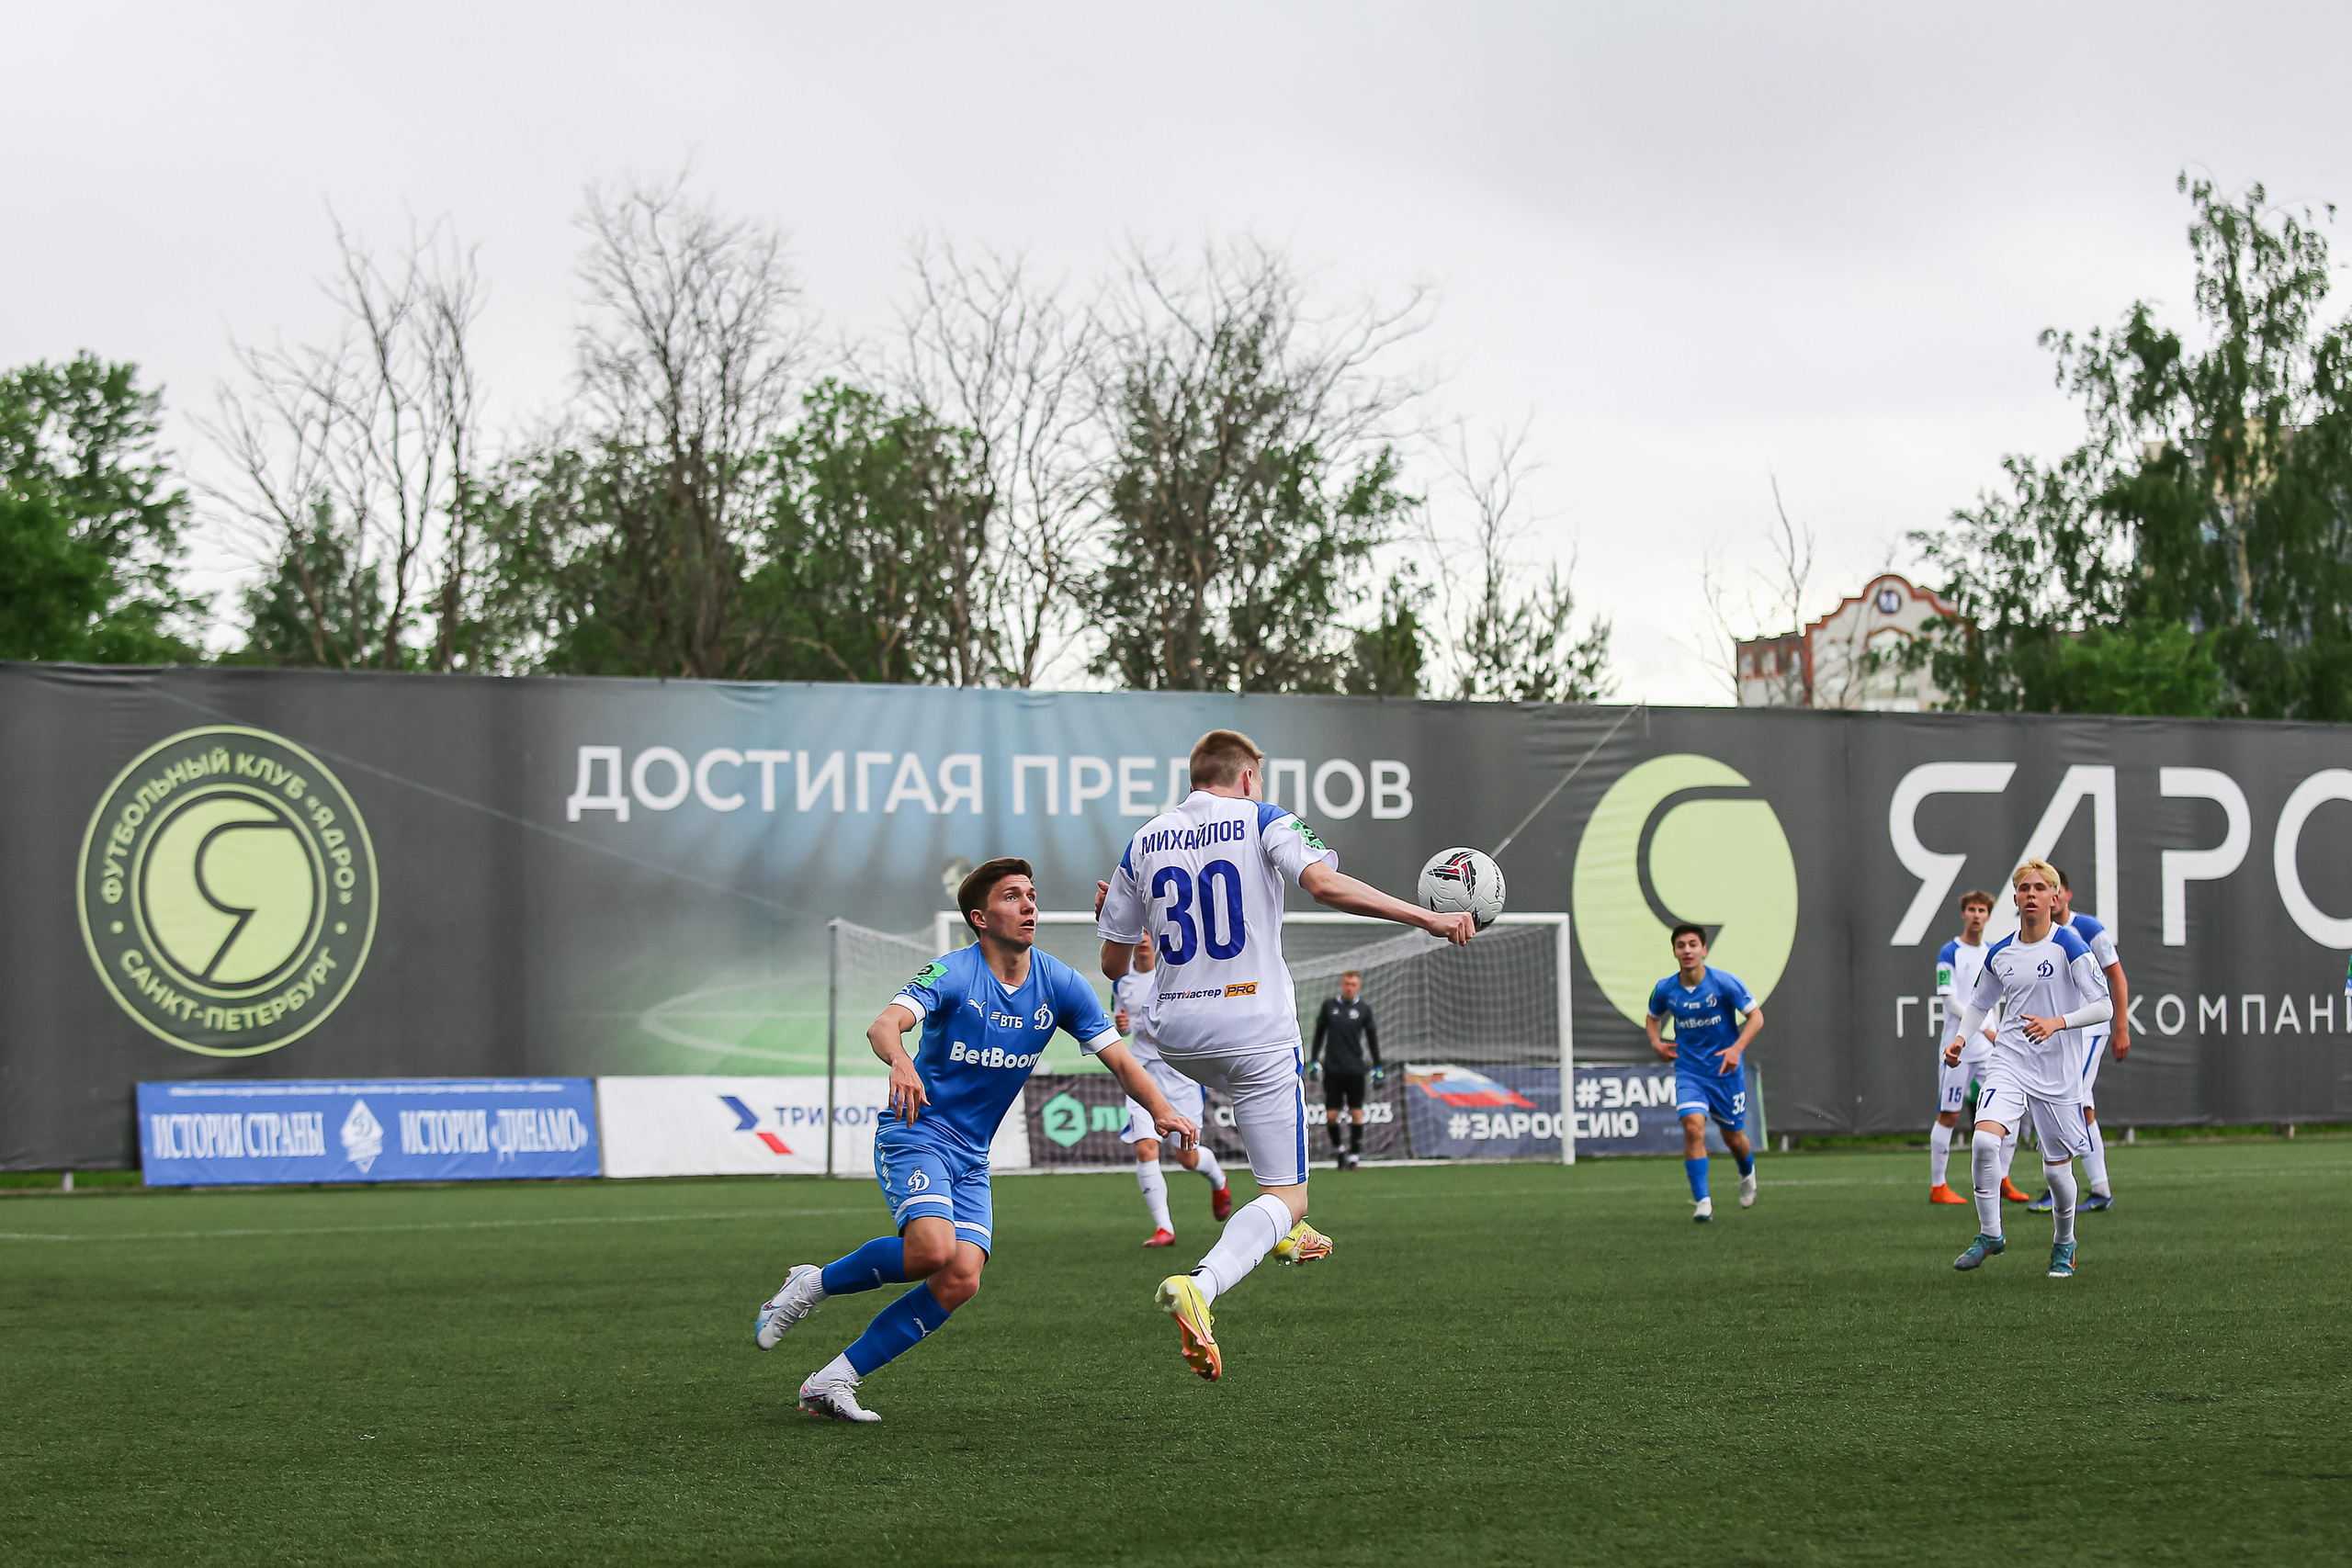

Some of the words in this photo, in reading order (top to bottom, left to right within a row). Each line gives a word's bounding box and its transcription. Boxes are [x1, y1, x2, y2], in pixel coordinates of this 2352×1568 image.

[566, 745, 983, 823] ДОСТИГАЯ
[1012, 755, 1415, 821] ПРЕЛОВ
[100, 745, 230, 905] ФУТБОЛЬНЫЙ
[235, 752, 308, 800] КЛУБ
[1140, 818, 1246, 856] МИХАЙЛОВ
[1151, 859, 1246, 965] 30
[119, 946, 338, 1032] САНКТ-ПЕТЕРБУРГ
[1226, 983, 1257, 997] PRO
[1000, 1015, 1023, 1030] ВТБ
[949, 1041, 1041, 1069] BetBoom
[1732, 1091, 1746, 1115] 32
[1948, 1087, 1962, 1102] 15
[398, 1109, 490, 1155] ИСТОРИЯ
[775, 1105, 877, 1126] ТРИКОЛ
[1447, 1111, 1640, 1141] #ЗАРОССИЮ
[152, 1112, 245, 1159] ИСТОРИЯ
[243, 1111, 326, 1158] СТРАНЫ
